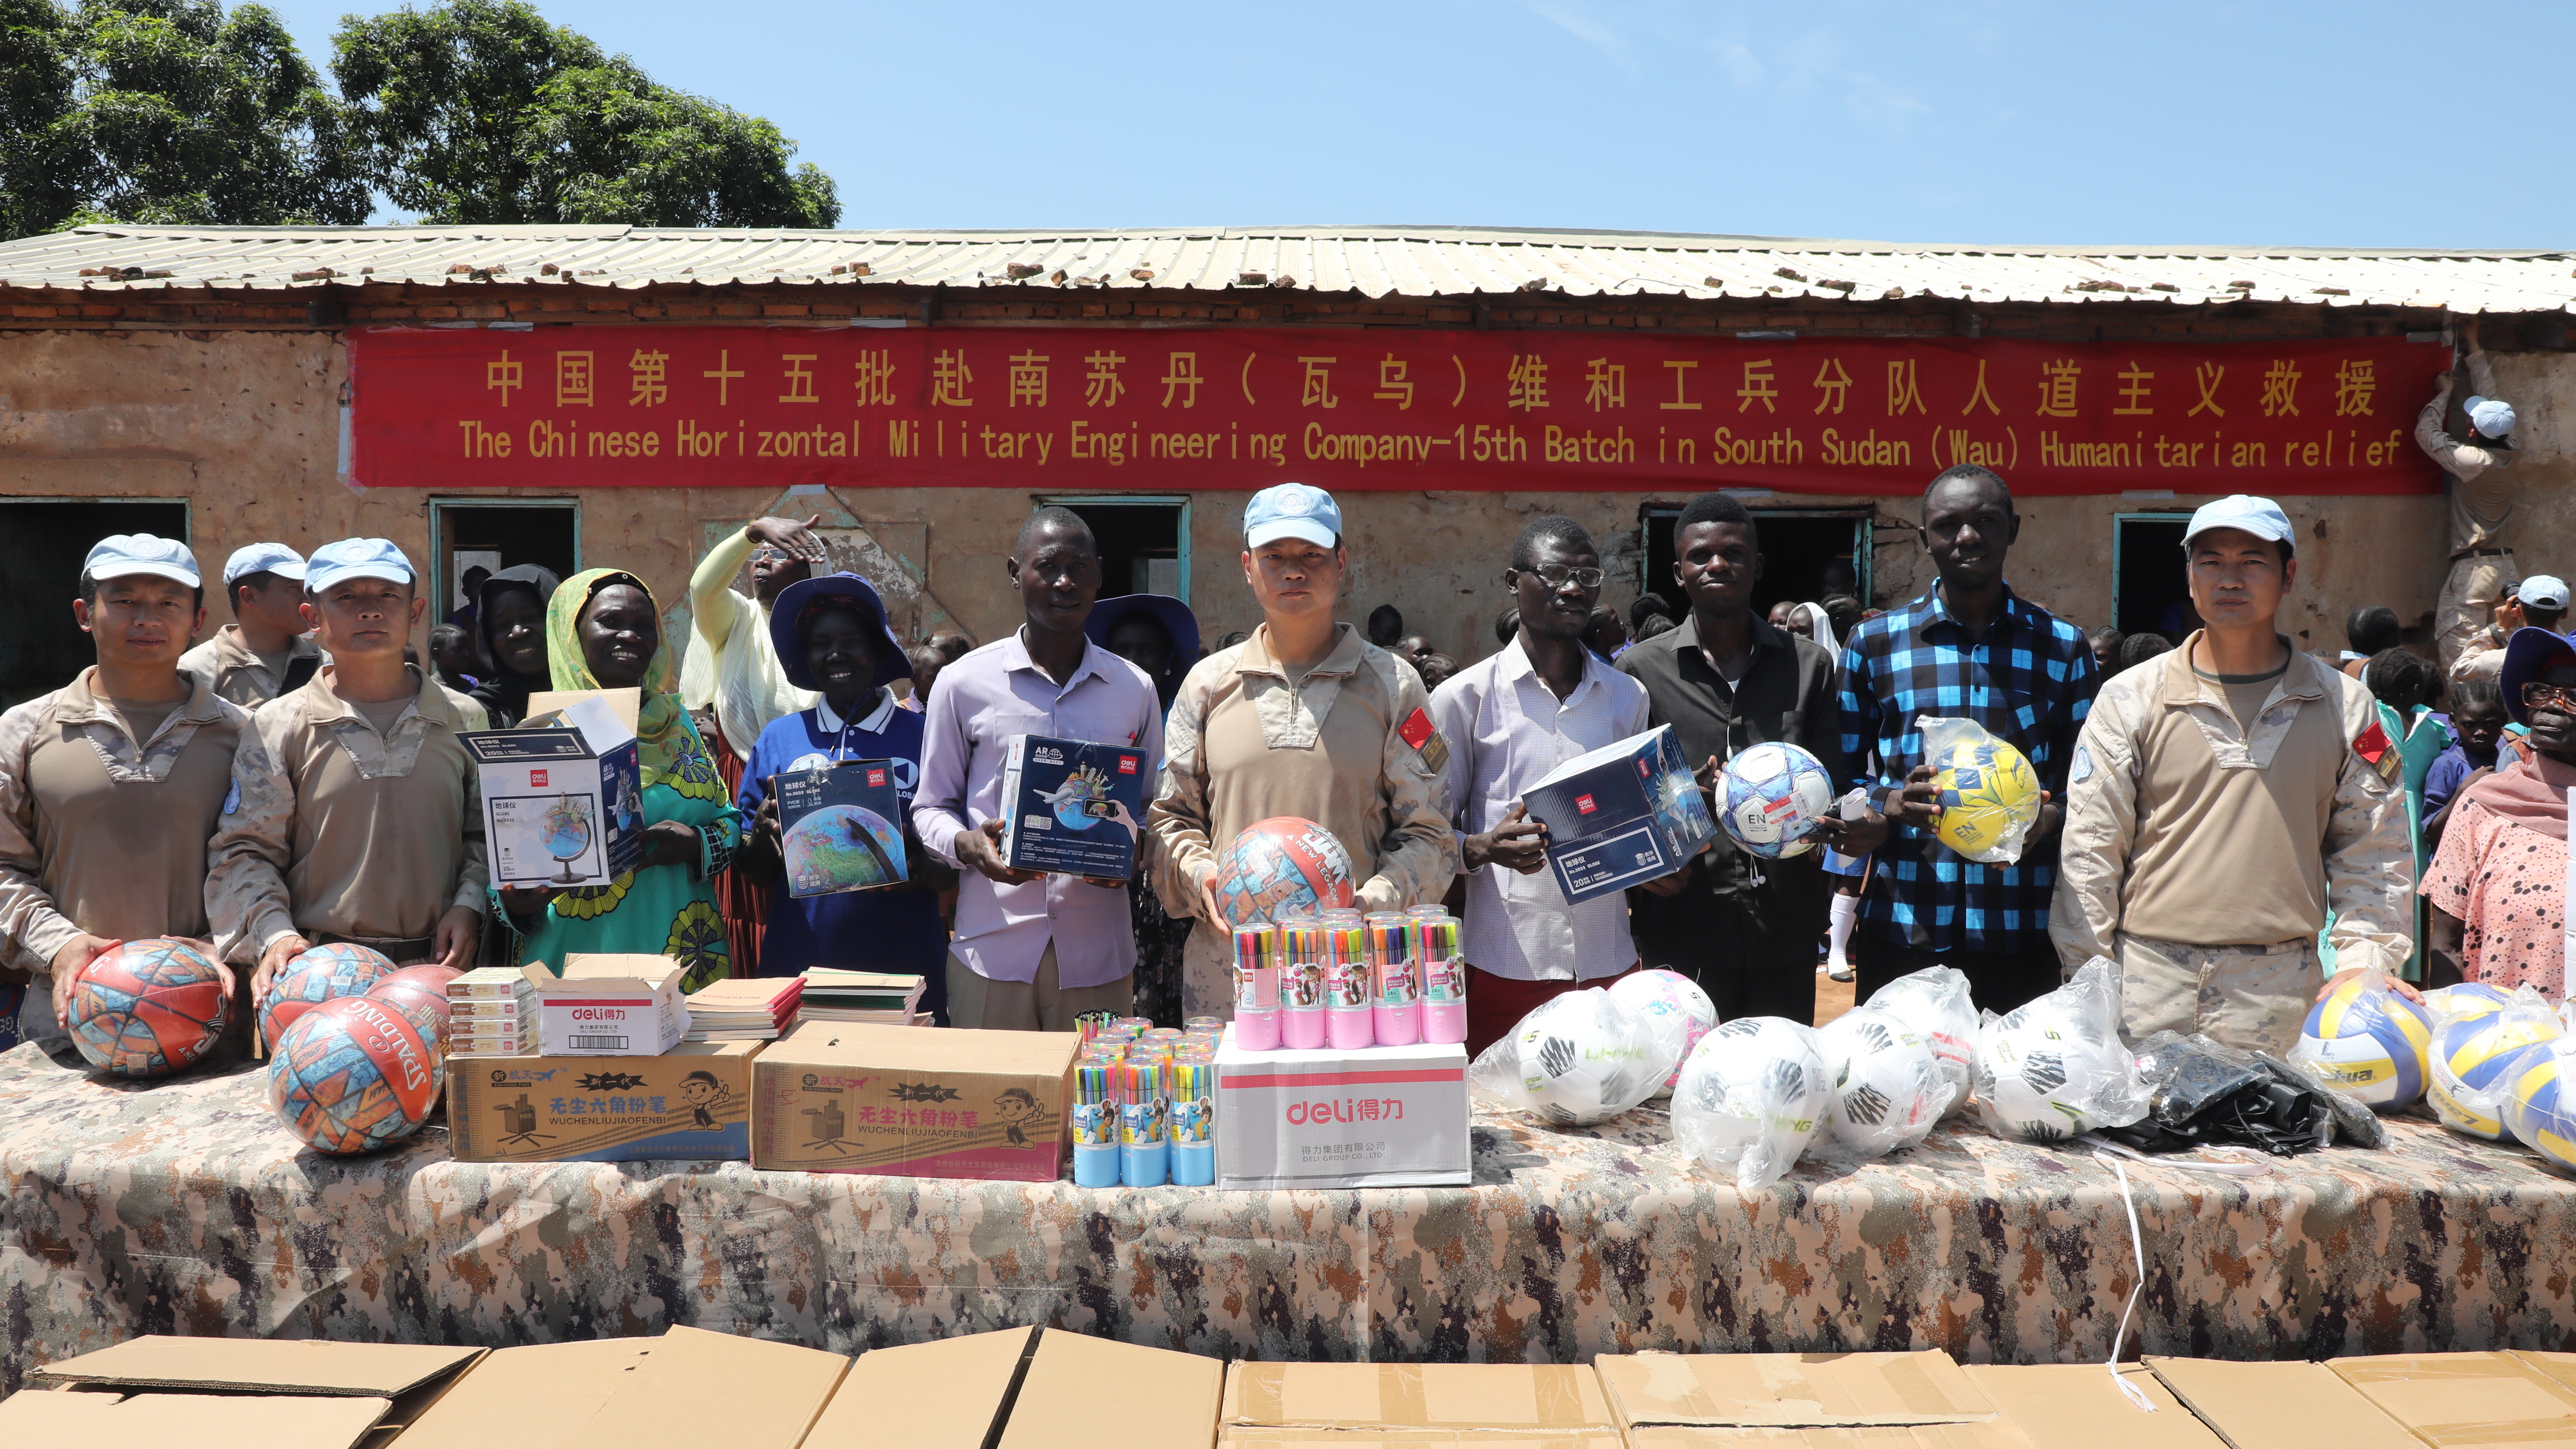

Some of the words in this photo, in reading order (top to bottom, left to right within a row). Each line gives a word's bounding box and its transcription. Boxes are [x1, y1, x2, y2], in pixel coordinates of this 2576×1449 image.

[460, 421, 511, 457] The
[529, 420, 659, 457] Chinese
[677, 419, 859, 457] Horizontal
[890, 420, 1053, 465] Military
[1071, 421, 1287, 467] Engineering
[1545, 425, 1635, 463] Batch
[1660, 427, 1695, 464] in
[1714, 427, 1804, 465] South
[1822, 428, 1911, 466] Sudan
[1932, 426, 2018, 470] (Wau)
[2041, 429, 2266, 467] Humanitarian
[2285, 428, 2402, 467] relief
[1035, 746, 1048, 754] AR
[785, 781, 806, 790] 地球仪
[1579, 798, 1592, 807] deli
[1748, 814, 1766, 824] EN
[1953, 821, 1977, 838] EN
[1565, 856, 1586, 868] 地球仪
[1569, 866, 1586, 874] No.3033
[1587, 861, 1601, 869] GLOBE
[1295, 840, 1318, 858] NEW
[1316, 860, 1339, 901] LEGACY
[1573, 879, 1584, 888] 20
[1528, 1030, 1540, 1043] 5
[342, 999, 428, 1091] SPALDING
[2003, 1040, 2018, 1061] Official
[1996, 1044, 2008, 1063] Weight
[1817, 1068, 1827, 1092] EN
[549, 1095, 667, 1115] 无尘六角粉笔
[549, 1116, 666, 1125] WUCHENLIUJIAOFENBI
[858, 1106, 979, 1128] 无尘六角粉笔
[858, 1125, 978, 1138] WUCHENLIUJIAOFENBI
[1301, 1142, 1385, 1155] 得力集团有限公司
